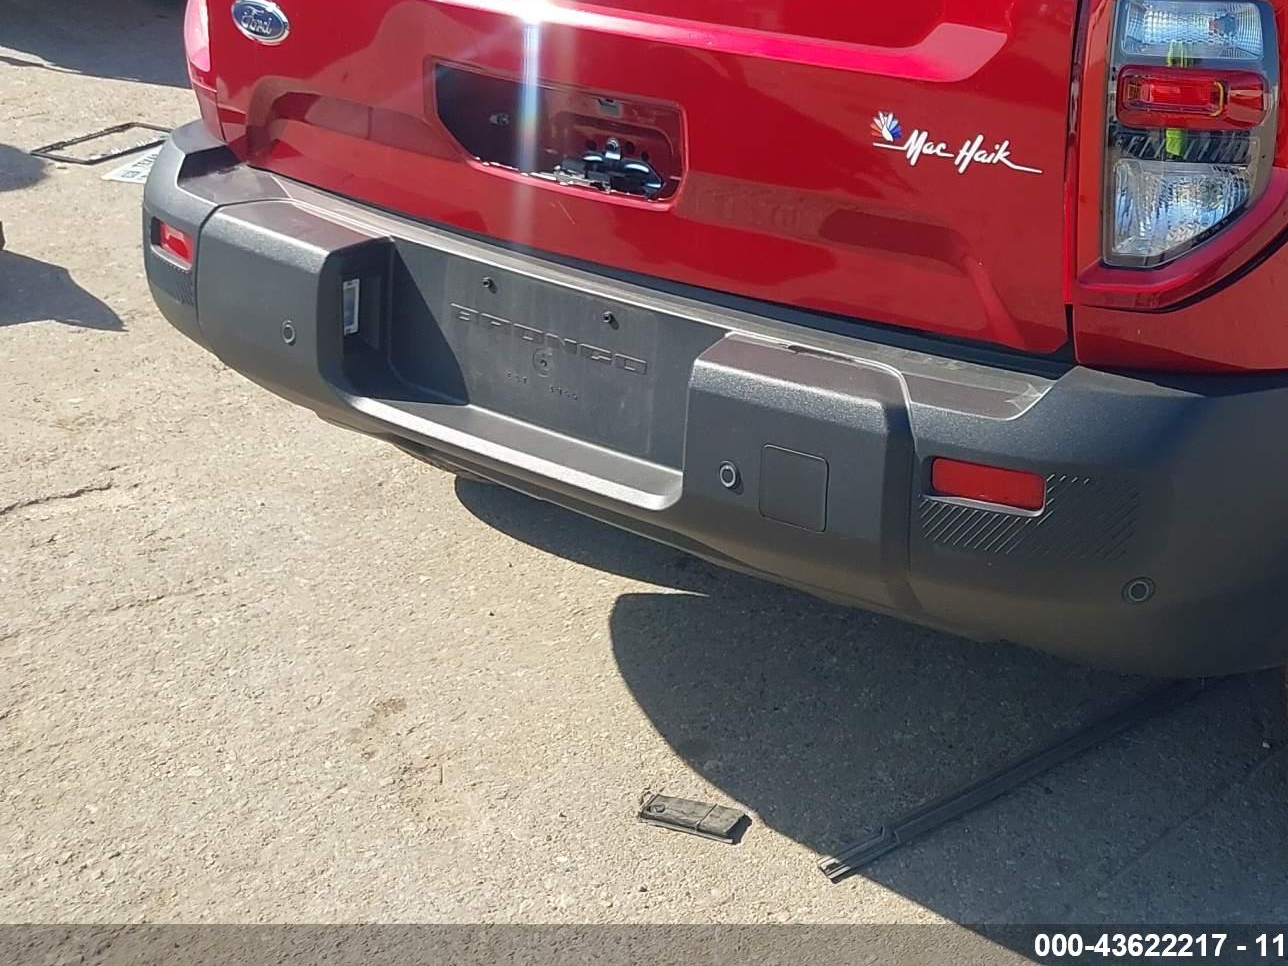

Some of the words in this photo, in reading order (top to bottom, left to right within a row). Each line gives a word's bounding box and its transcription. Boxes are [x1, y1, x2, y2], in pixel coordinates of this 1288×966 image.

[906, 129, 954, 166] Mac
[954, 135, 1043, 174] Haik
[450, 302, 648, 376] BRONCO
